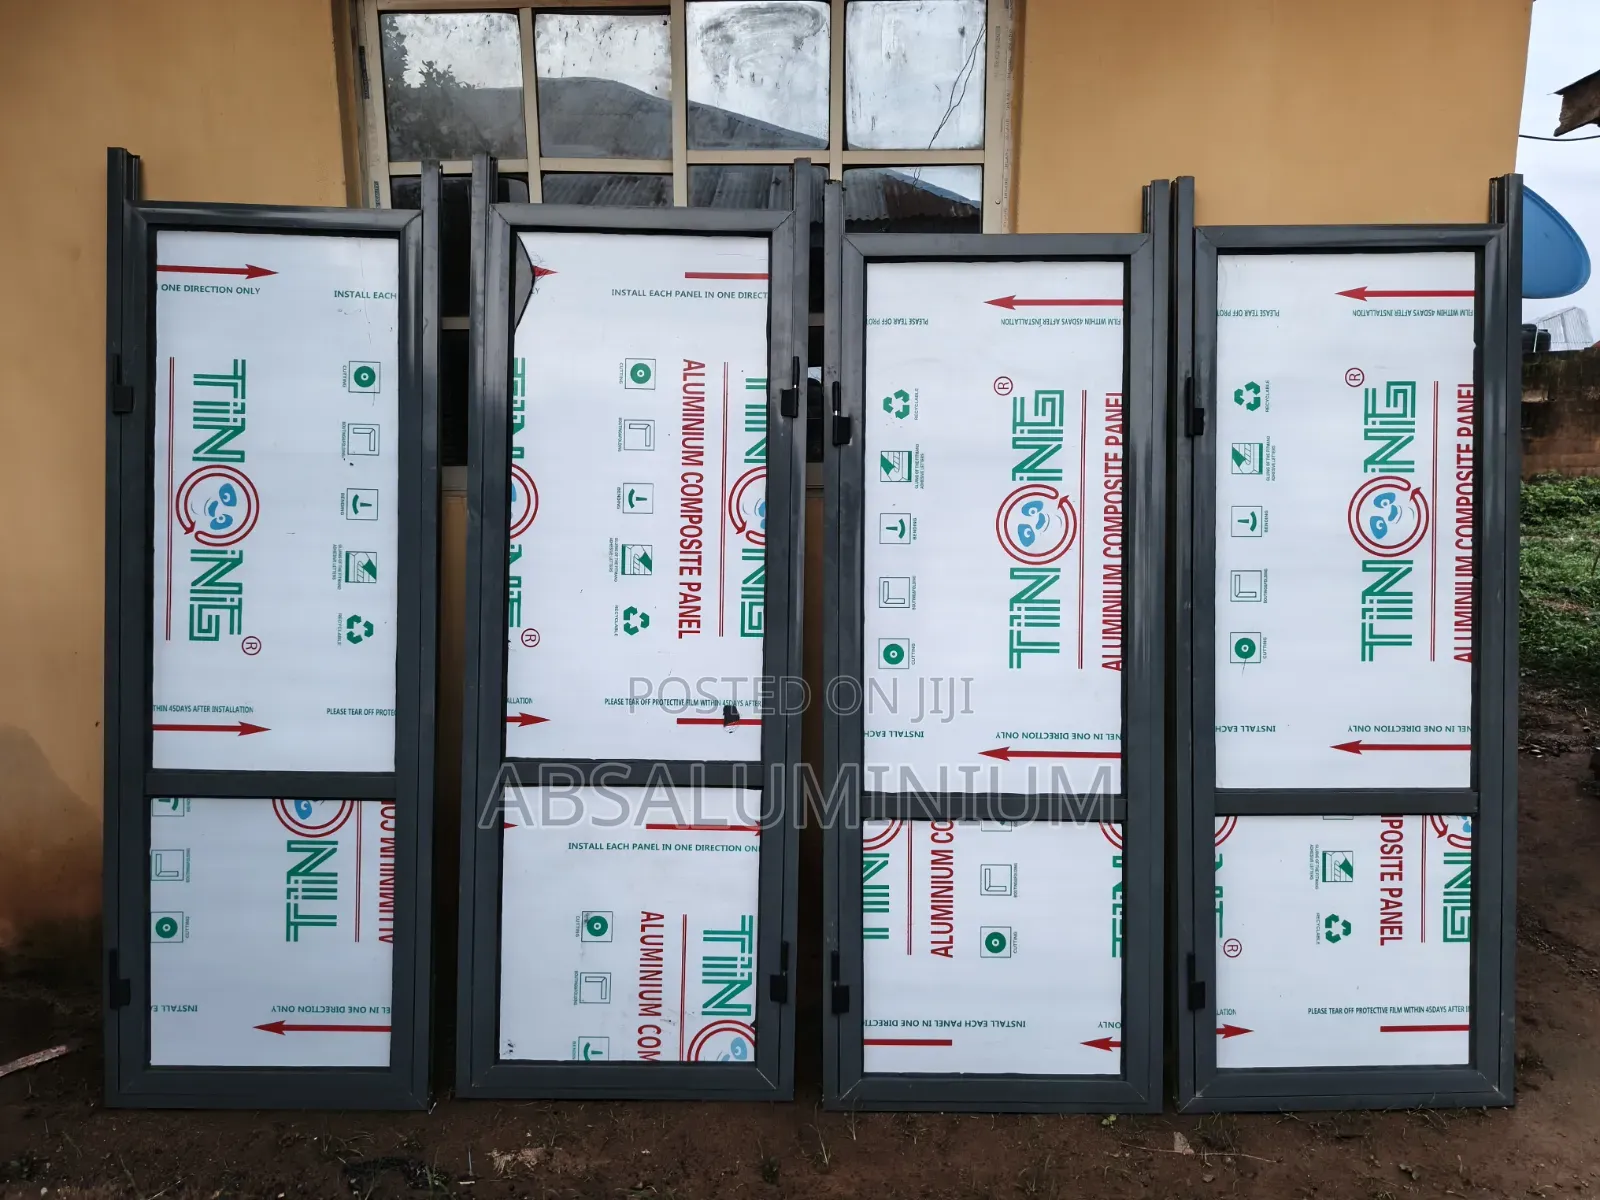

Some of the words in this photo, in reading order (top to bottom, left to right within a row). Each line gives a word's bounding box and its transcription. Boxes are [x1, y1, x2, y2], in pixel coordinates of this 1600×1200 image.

[161, 284, 181, 292] ONE
[183, 285, 233, 293] DIRECTION
[236, 286, 261, 294] ONLY
[334, 291, 370, 299] INSTALL
[373, 292, 397, 300] EACH
[681, 359, 706, 466] ALUMINIUM
[679, 472, 704, 576] COMPOSITE
[678, 583, 702, 639] PANEL
[1380, 815, 1403, 882] POSITE
[930, 850, 953, 958] ALUMINIUM
[1380, 887, 1403, 946] PANEL
[638, 911, 664, 1017] ALUMINIUM
